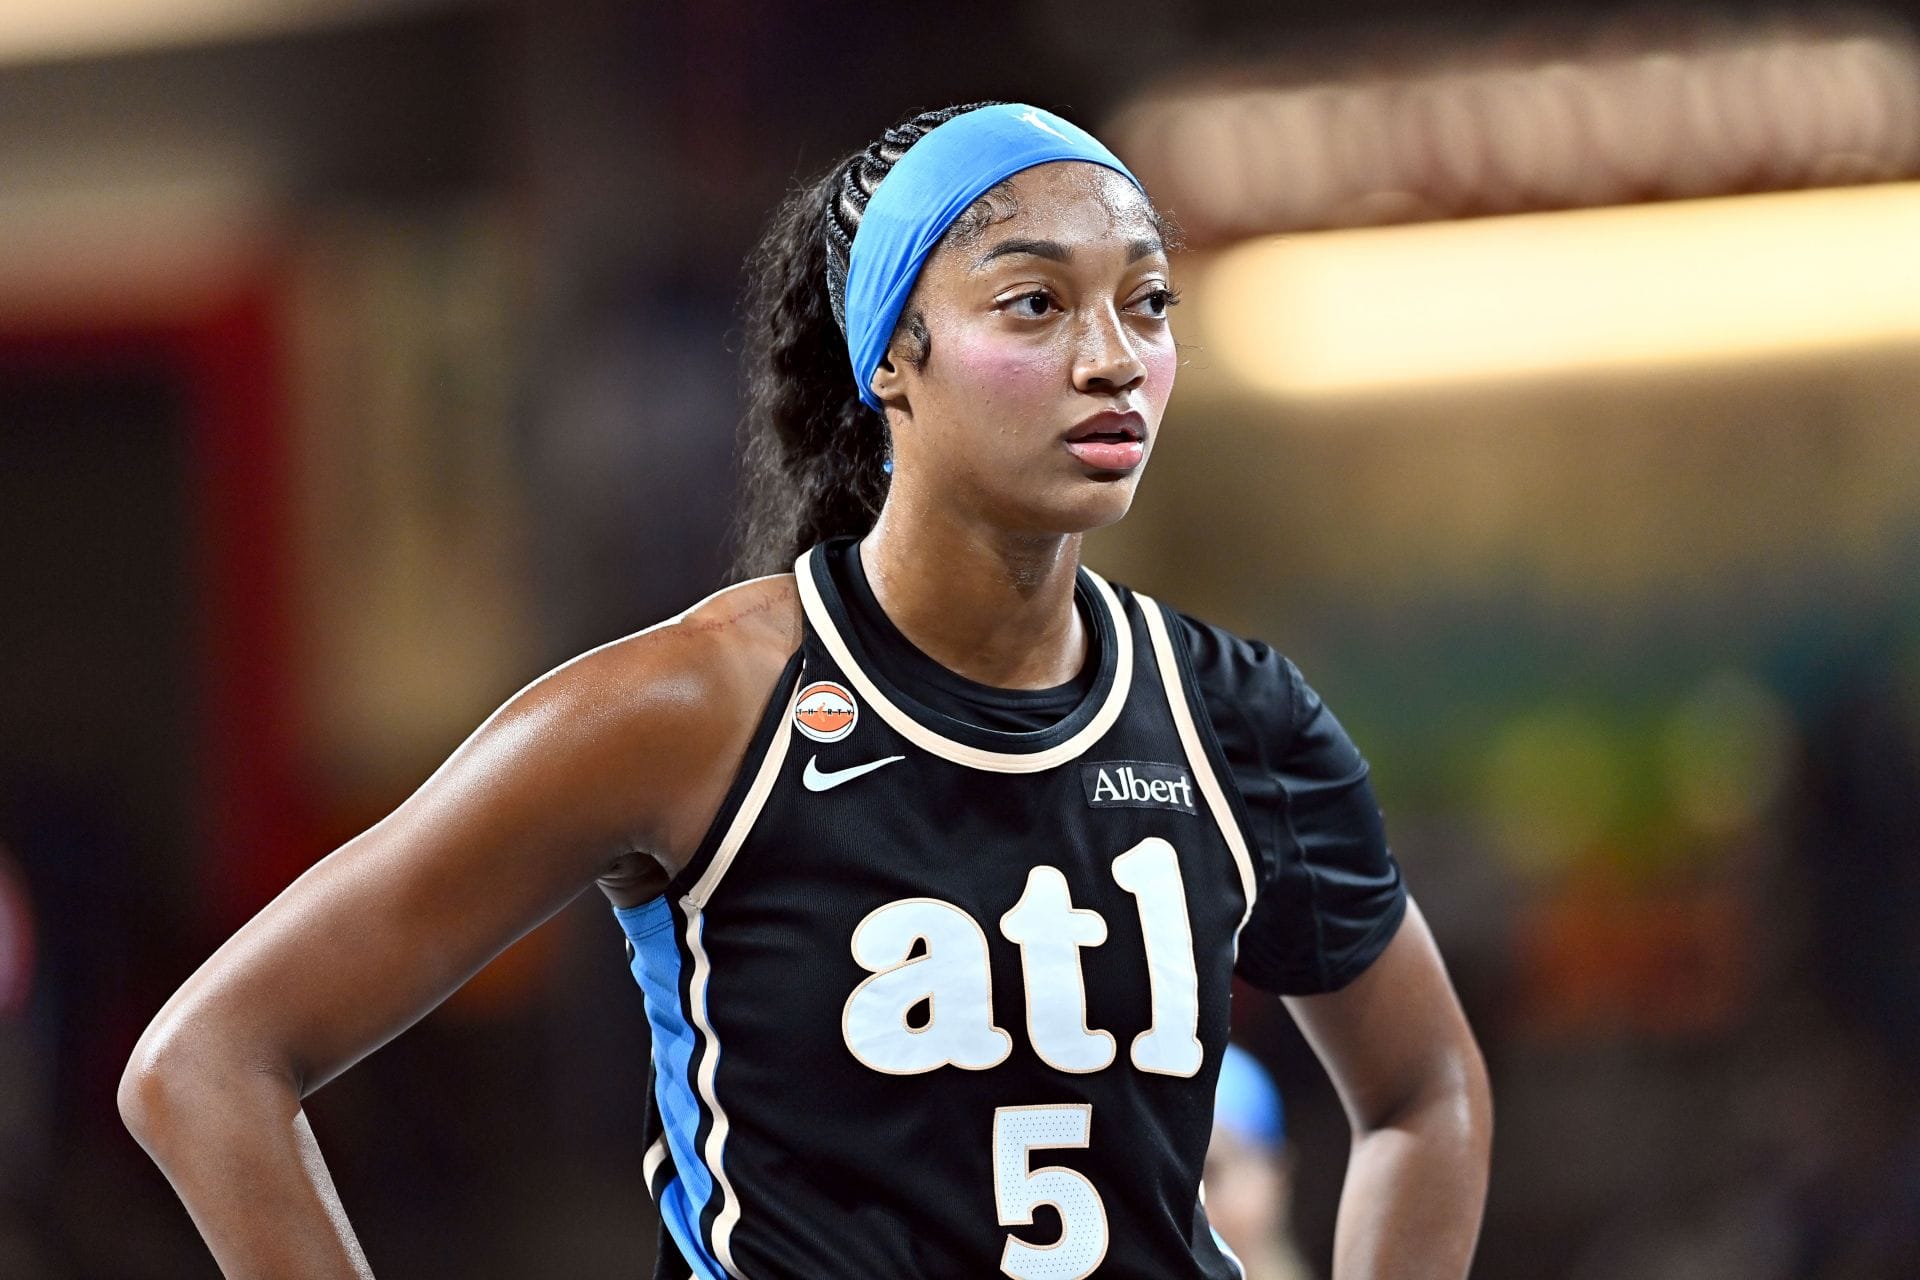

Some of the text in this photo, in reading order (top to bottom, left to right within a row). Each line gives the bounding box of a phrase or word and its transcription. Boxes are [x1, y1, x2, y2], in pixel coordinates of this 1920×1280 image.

[1091, 766, 1193, 808] Albert
[842, 837, 1203, 1078] atl
[992, 1103, 1109, 1280] 5
